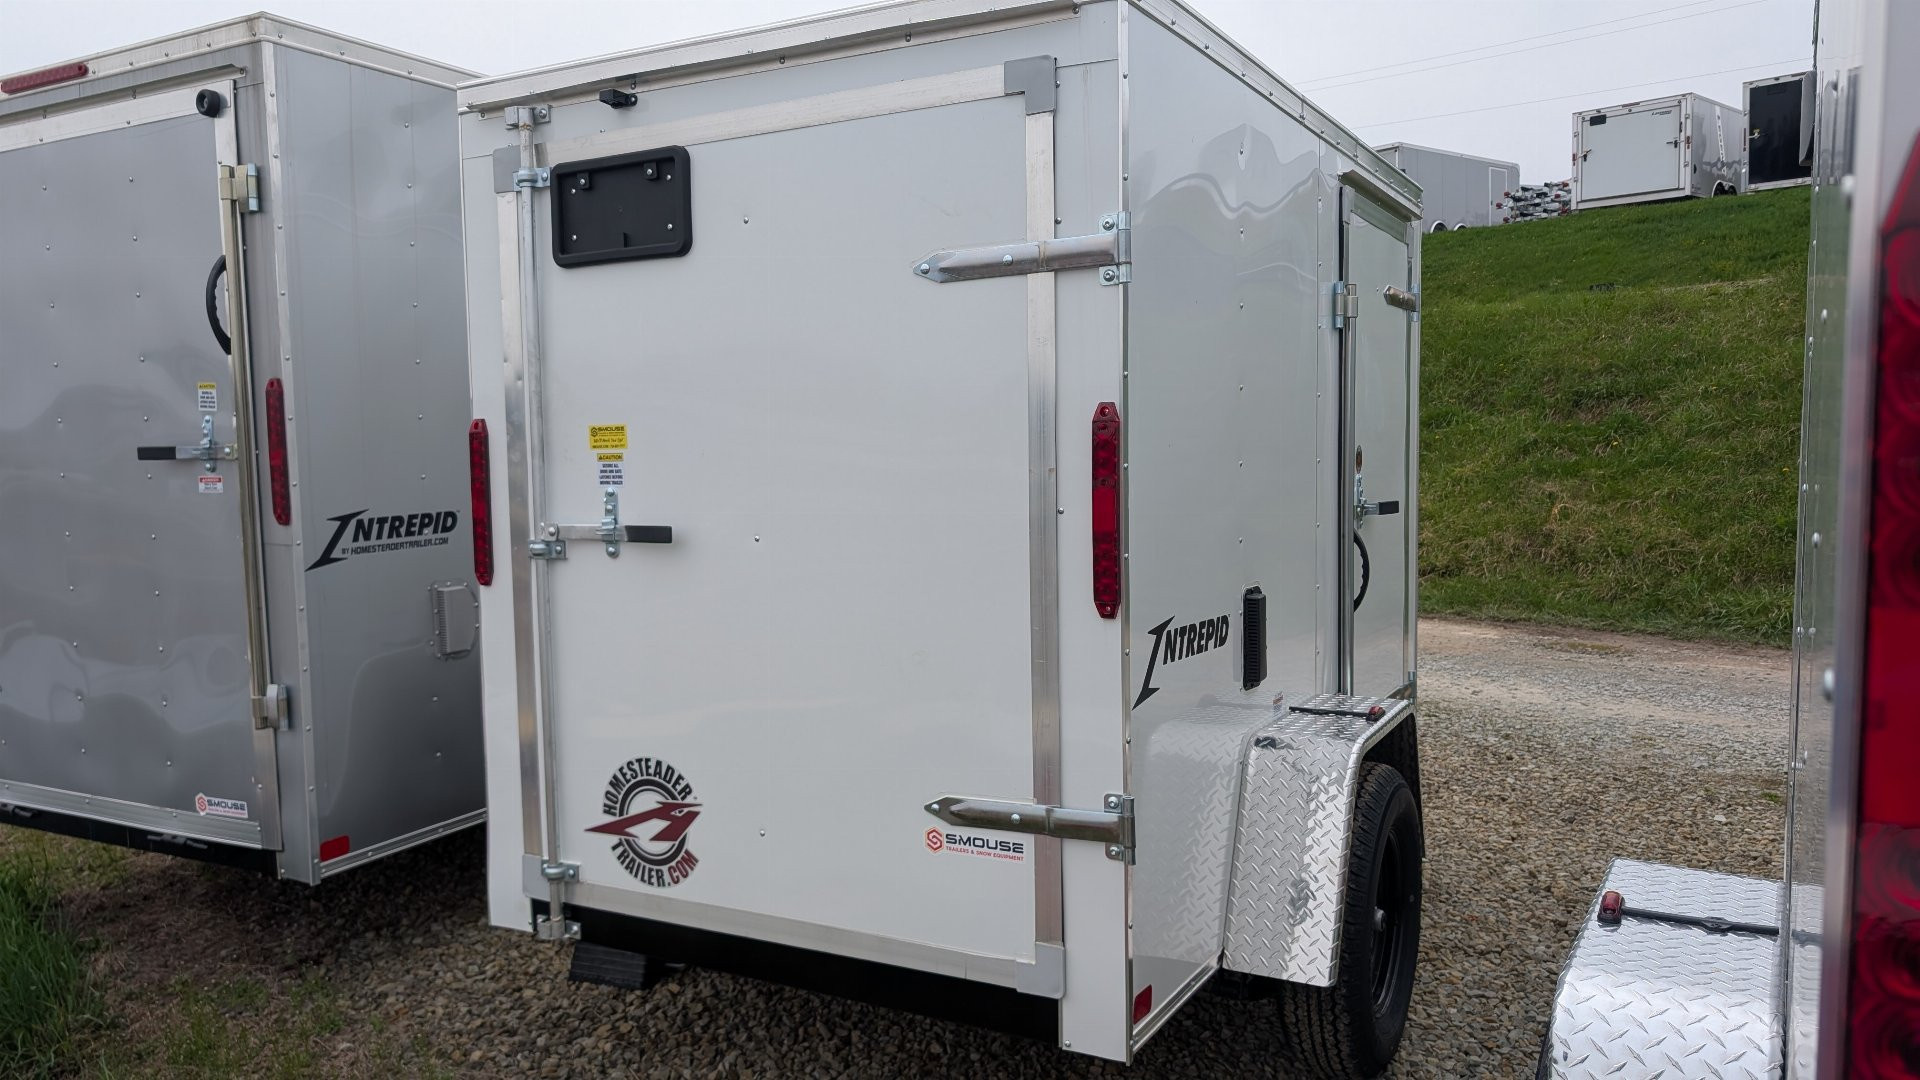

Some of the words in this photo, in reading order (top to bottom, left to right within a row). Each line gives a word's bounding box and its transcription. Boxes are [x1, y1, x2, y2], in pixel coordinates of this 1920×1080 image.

[304, 508, 458, 572] INTREPID
[351, 537, 449, 555] HOMESTEADERTRAILER.COM
[1132, 615, 1229, 711] INTREPID
[603, 757, 693, 817] HOMESTEADER
[206, 799, 247, 811] SMOUSE
[945, 833, 1024, 854] SMOUSE
[946, 846, 970, 854] TRAILERS
[993, 853, 1024, 862] EQUIPMENT
